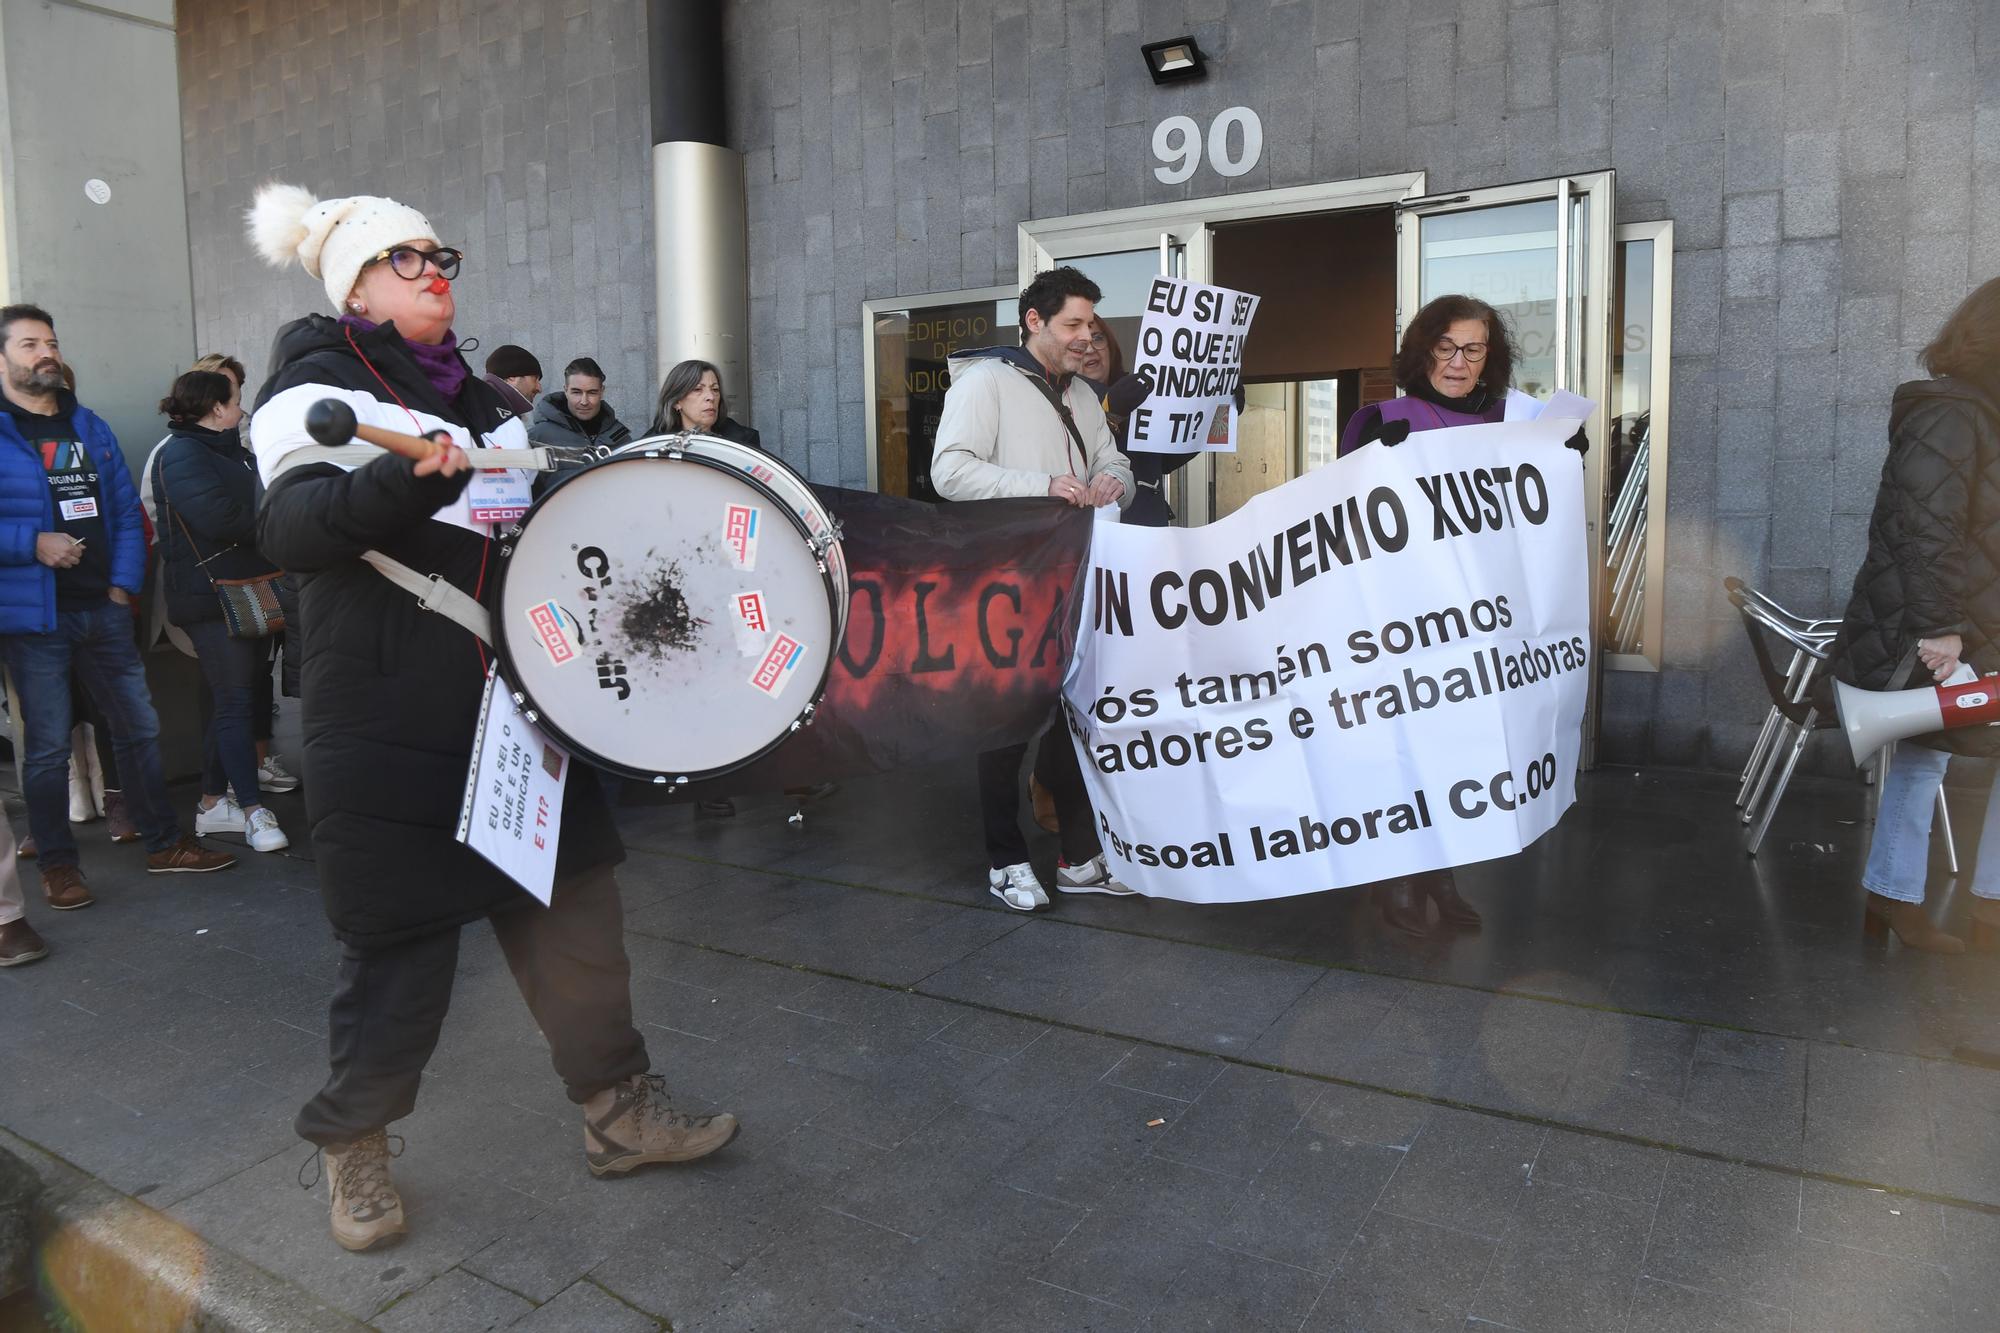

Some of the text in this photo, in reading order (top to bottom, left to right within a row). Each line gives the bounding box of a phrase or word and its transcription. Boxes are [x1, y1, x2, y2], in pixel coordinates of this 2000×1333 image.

[1151, 106, 1264, 185] 90
[905, 316, 988, 342] EDIFICIO
[1148, 279, 1253, 326] EU SI SEI
[1143, 327, 1163, 357] O
[1172, 327, 1224, 364] QUE
[1138, 363, 1240, 398] SINDICATO
[1134, 408, 1204, 443] E TI?
[476, 510, 525, 520] CCOO
[730, 510, 747, 552] CCO
[1150, 485, 1409, 630] CONVENIO
[1416, 462, 1549, 541] XUSTO
[535, 607, 569, 660] CCOO
[840, 578, 1066, 680] OLGA
[1175, 642, 1332, 709] tamén
[1347, 595, 1512, 664] somos
[757, 639, 793, 687] CCOO
[1288, 706, 1315, 740] e
[1328, 636, 1587, 730] traballadoras
[488, 723, 512, 830] EU SI SEI O
[502, 742, 521, 831] QUE E UN
[513, 752, 533, 841] SINDICATO
[534, 795, 551, 851] E TI?
[1100, 752, 1556, 870] Persoal laboral CC.OO
